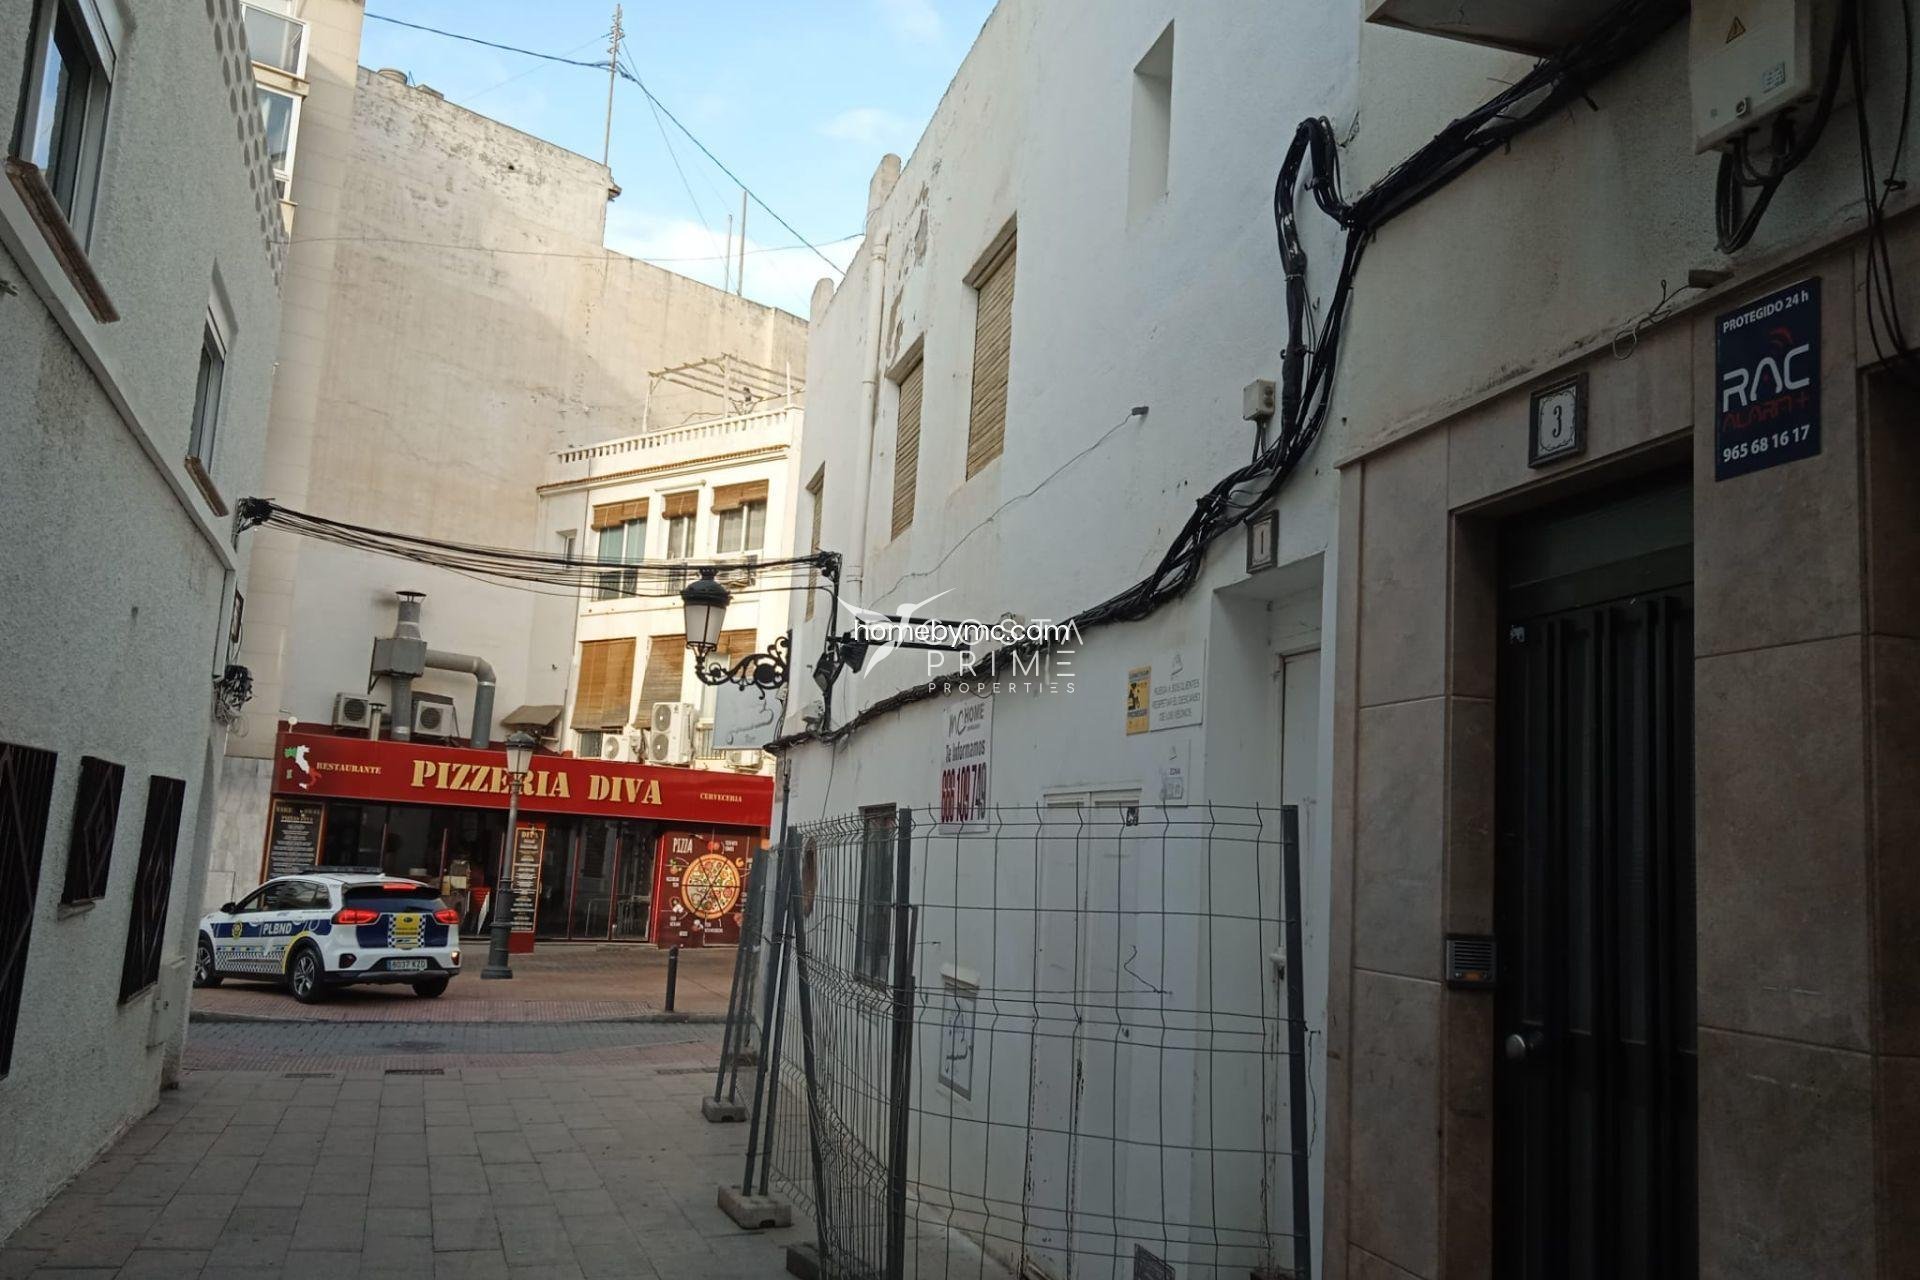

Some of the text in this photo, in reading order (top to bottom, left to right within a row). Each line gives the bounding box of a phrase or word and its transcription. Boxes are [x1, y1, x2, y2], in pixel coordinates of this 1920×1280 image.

[1723, 290, 1809, 334] PROTEGIDO 24 h
[1723, 344, 1810, 413] RAC
[1552, 405, 1562, 438] 3
[1723, 424, 1810, 463] 965 68 16 17
[316, 762, 382, 775] RESTAURANTE
[411, 759, 662, 805] PIZZERIA DIVA
[672, 838, 693, 854] PIZZA
[263, 922, 292, 935] PLBND
